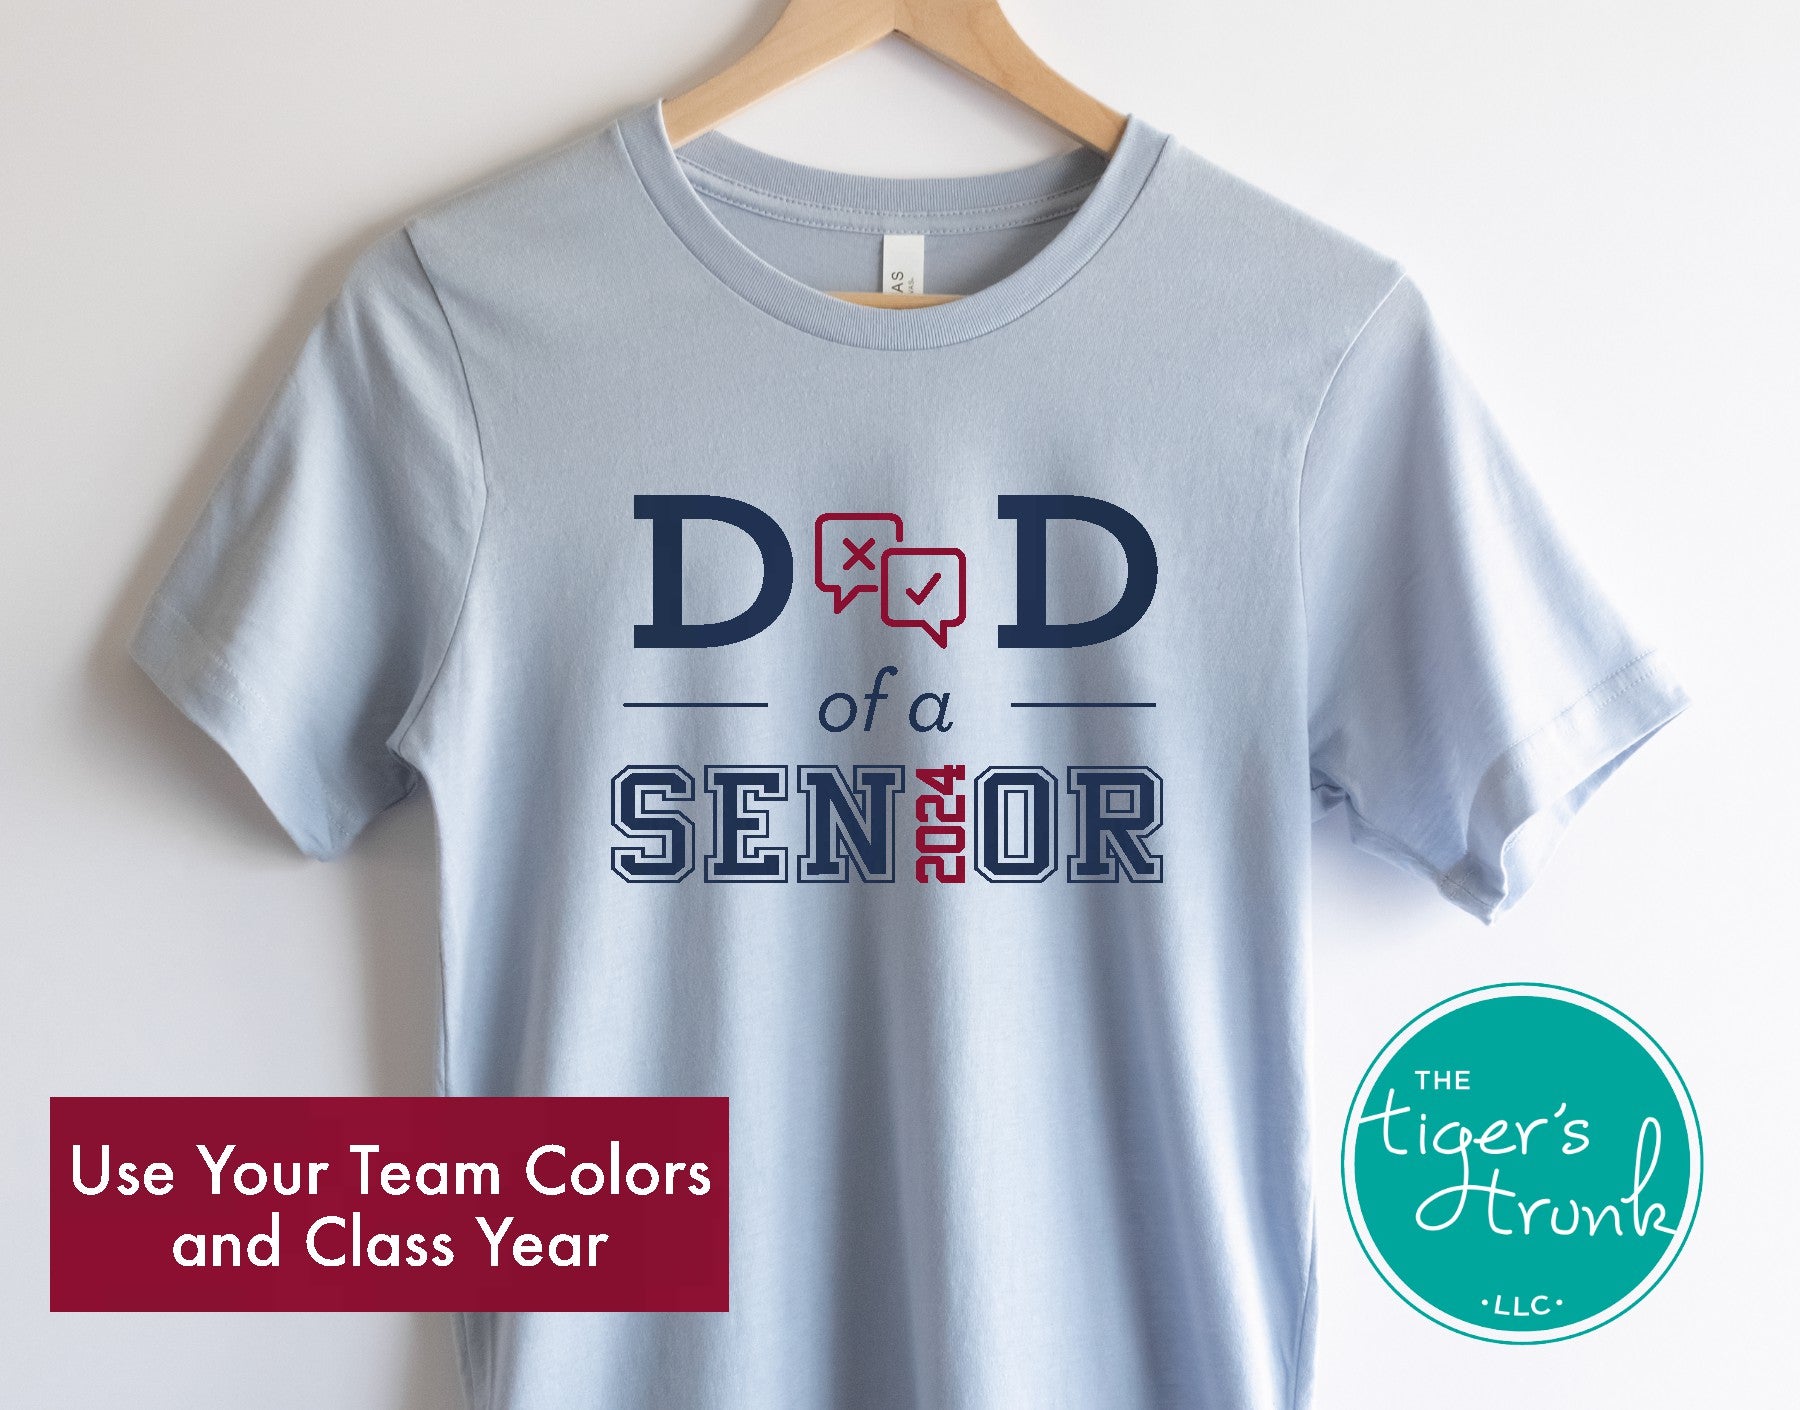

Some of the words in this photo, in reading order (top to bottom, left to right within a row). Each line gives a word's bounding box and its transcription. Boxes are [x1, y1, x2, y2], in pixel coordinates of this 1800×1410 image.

[818, 665, 899, 733] of
[908, 692, 954, 733] a
[915, 764, 966, 884] 2024
